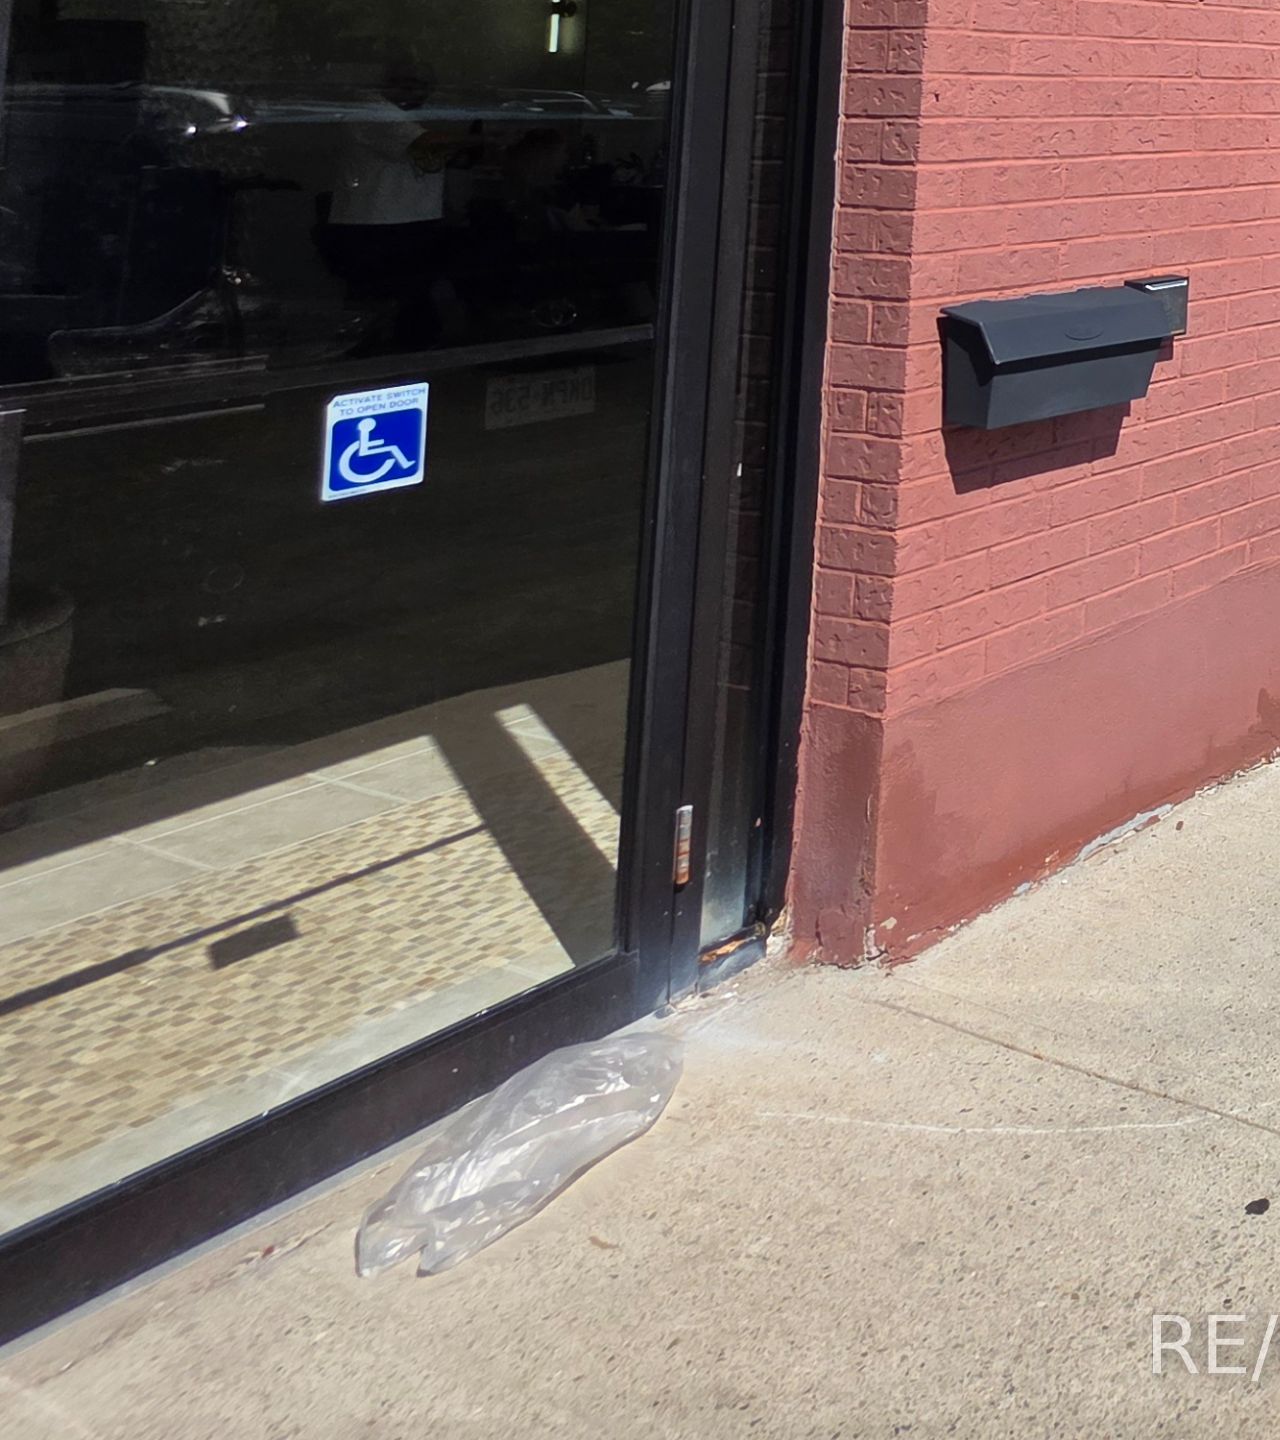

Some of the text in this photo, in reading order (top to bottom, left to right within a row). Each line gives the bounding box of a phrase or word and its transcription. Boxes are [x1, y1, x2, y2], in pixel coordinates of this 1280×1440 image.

[333, 388, 426, 408] ACTIVATE SWITCH
[340, 398, 419, 416] TO OPEN DOOR
